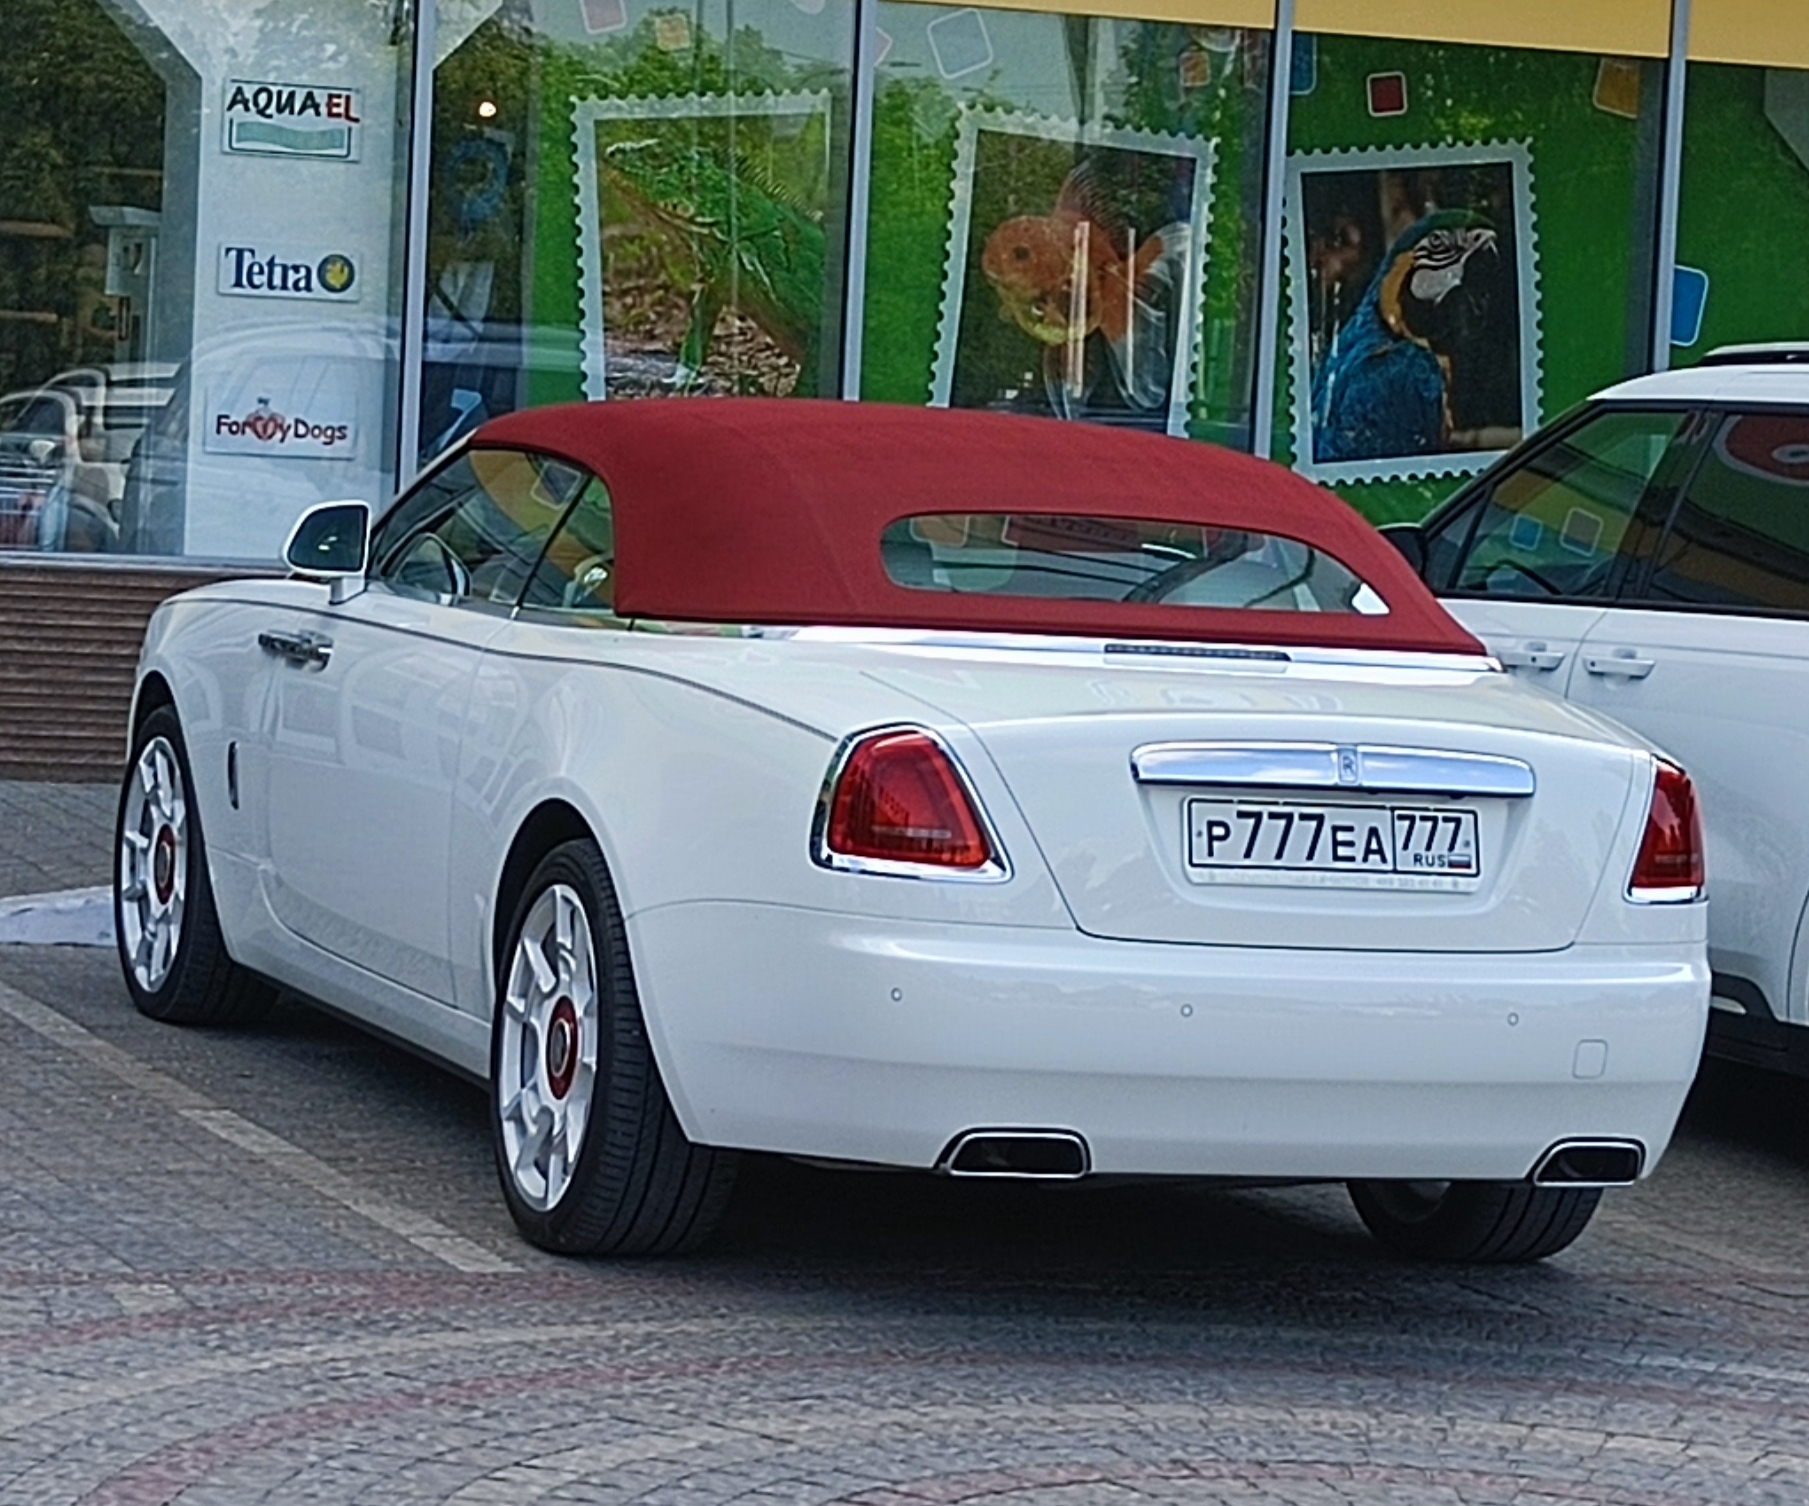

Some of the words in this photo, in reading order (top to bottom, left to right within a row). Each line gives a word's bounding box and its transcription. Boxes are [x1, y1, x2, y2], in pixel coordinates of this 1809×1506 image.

[226, 85, 360, 123] AQUAEL
[225, 247, 314, 292] Tetra
[294, 418, 348, 445] Dogs
[1396, 813, 1462, 851] 777
[1413, 853, 1447, 867] RUS
